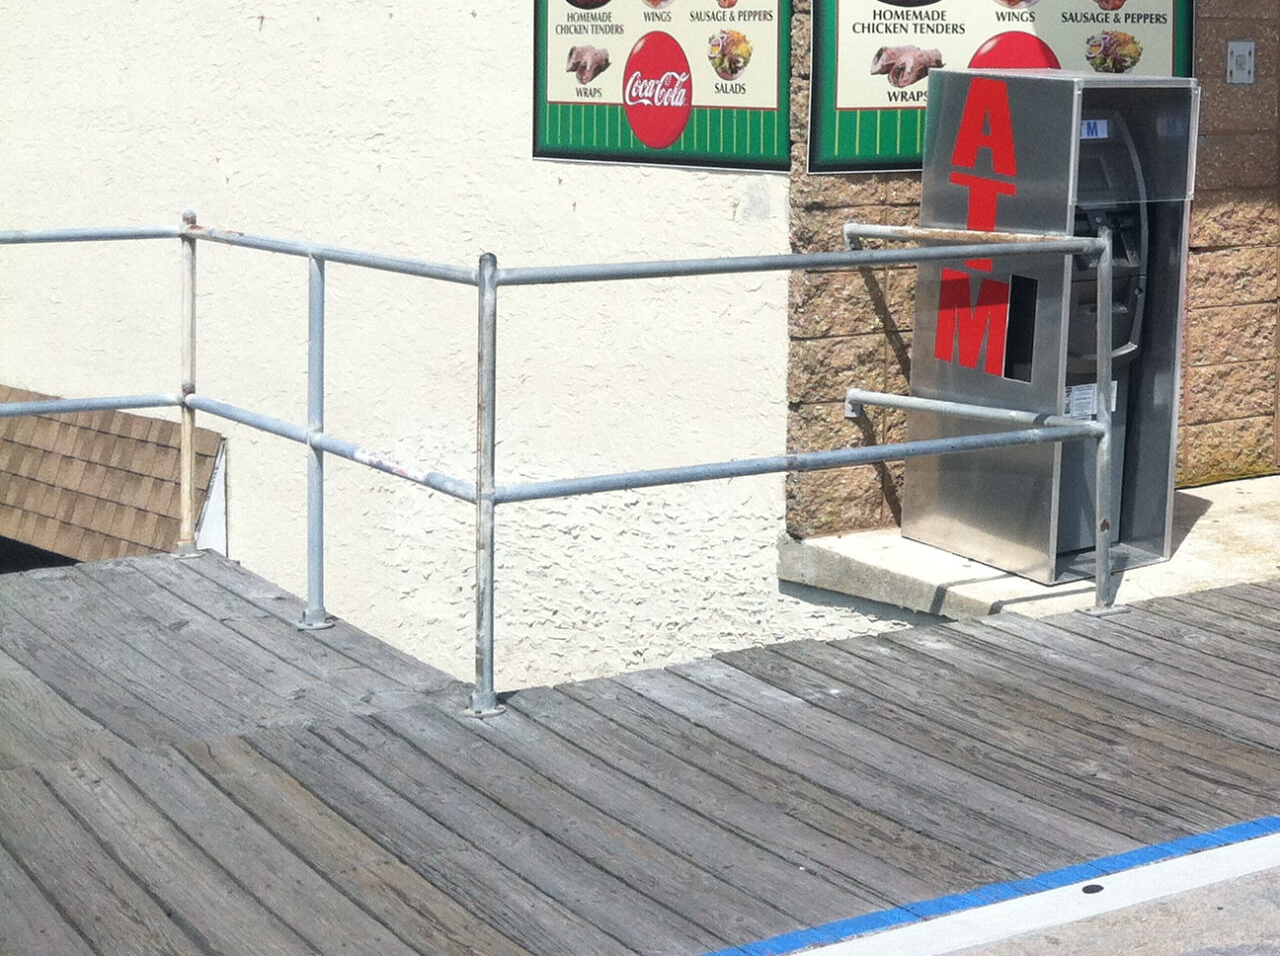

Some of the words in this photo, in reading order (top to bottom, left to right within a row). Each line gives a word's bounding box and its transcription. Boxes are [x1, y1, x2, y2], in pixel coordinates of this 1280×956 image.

[566, 11, 612, 23] HOMEMADE
[643, 11, 672, 22] WINGS
[689, 10, 727, 22] SAUSAGE
[728, 11, 736, 22] &
[737, 10, 774, 22] PEPPERS
[872, 9, 947, 22] HOMEMADE
[995, 11, 1036, 23] WINGS
[1061, 12, 1111, 24] SAUSAGE
[1112, 12, 1122, 24] &
[1123, 12, 1168, 25] PEPPERS
[555, 23, 588, 35] CHICKEN
[590, 23, 624, 35] TENDERS
[852, 22, 909, 35] CHICKEN
[912, 23, 966, 36] TENDERS
[575, 87, 602, 98] WRAPS
[714, 82, 746, 94] SALADS
[887, 90, 928, 102] WRAPS
